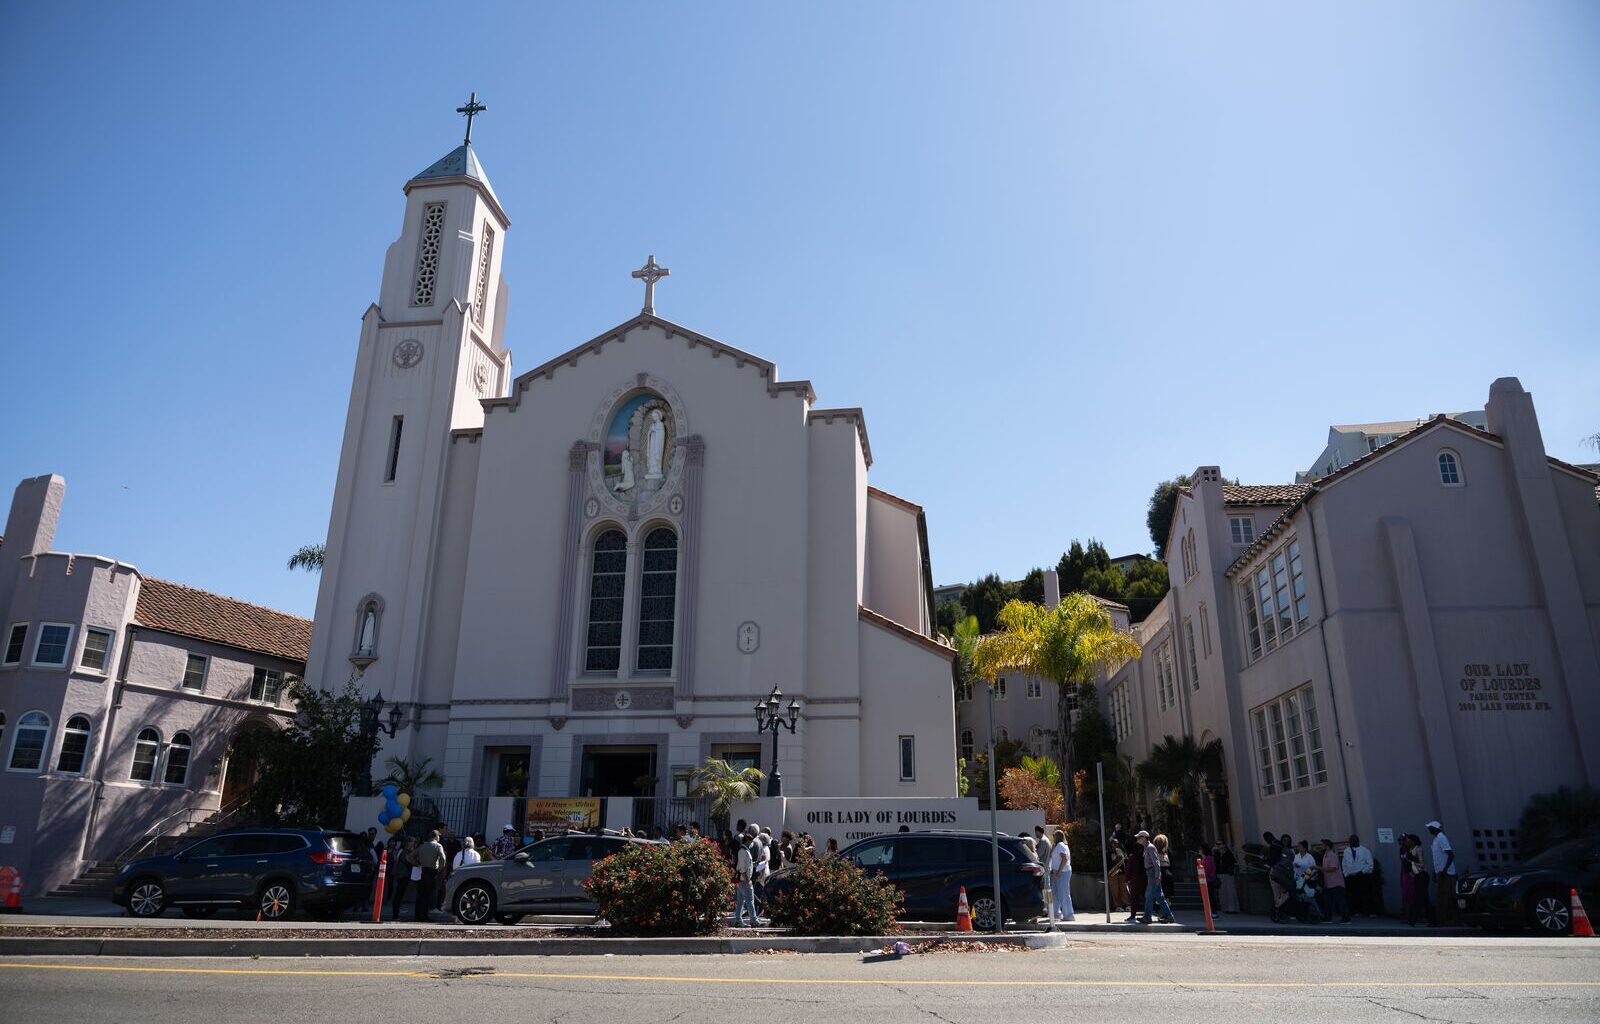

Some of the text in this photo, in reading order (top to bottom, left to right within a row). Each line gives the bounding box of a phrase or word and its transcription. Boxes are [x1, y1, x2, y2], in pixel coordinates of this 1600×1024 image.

[1464, 663, 1531, 677] OUR LADY
[1460, 678, 1542, 692] OF LOURDES
[1470, 692, 1537, 701] PARISH CENTER
[1480, 702, 1502, 711] LAKE
[553, 808, 582, 816] Welcome
[807, 810, 956, 824] OUR LADY OF LOURDES
